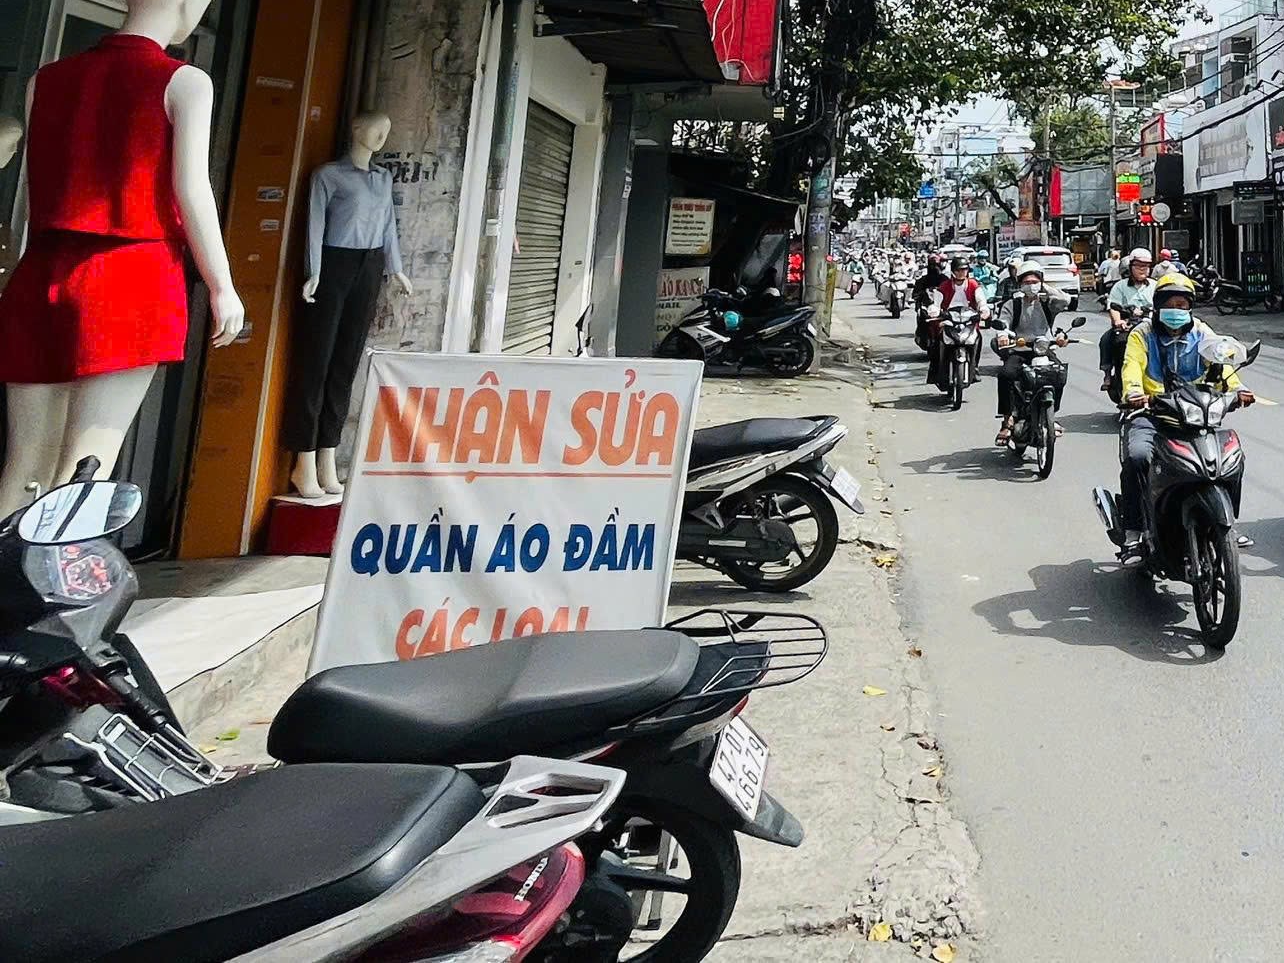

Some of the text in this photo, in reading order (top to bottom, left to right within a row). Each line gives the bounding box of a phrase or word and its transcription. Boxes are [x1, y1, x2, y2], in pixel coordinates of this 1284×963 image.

[363, 368, 681, 483] NHẬN SỬA
[350, 506, 656, 578] QUẦN ÁO ĐẦM
[394, 596, 480, 661] CÁC
[513, 856, 549, 903] HONDA
